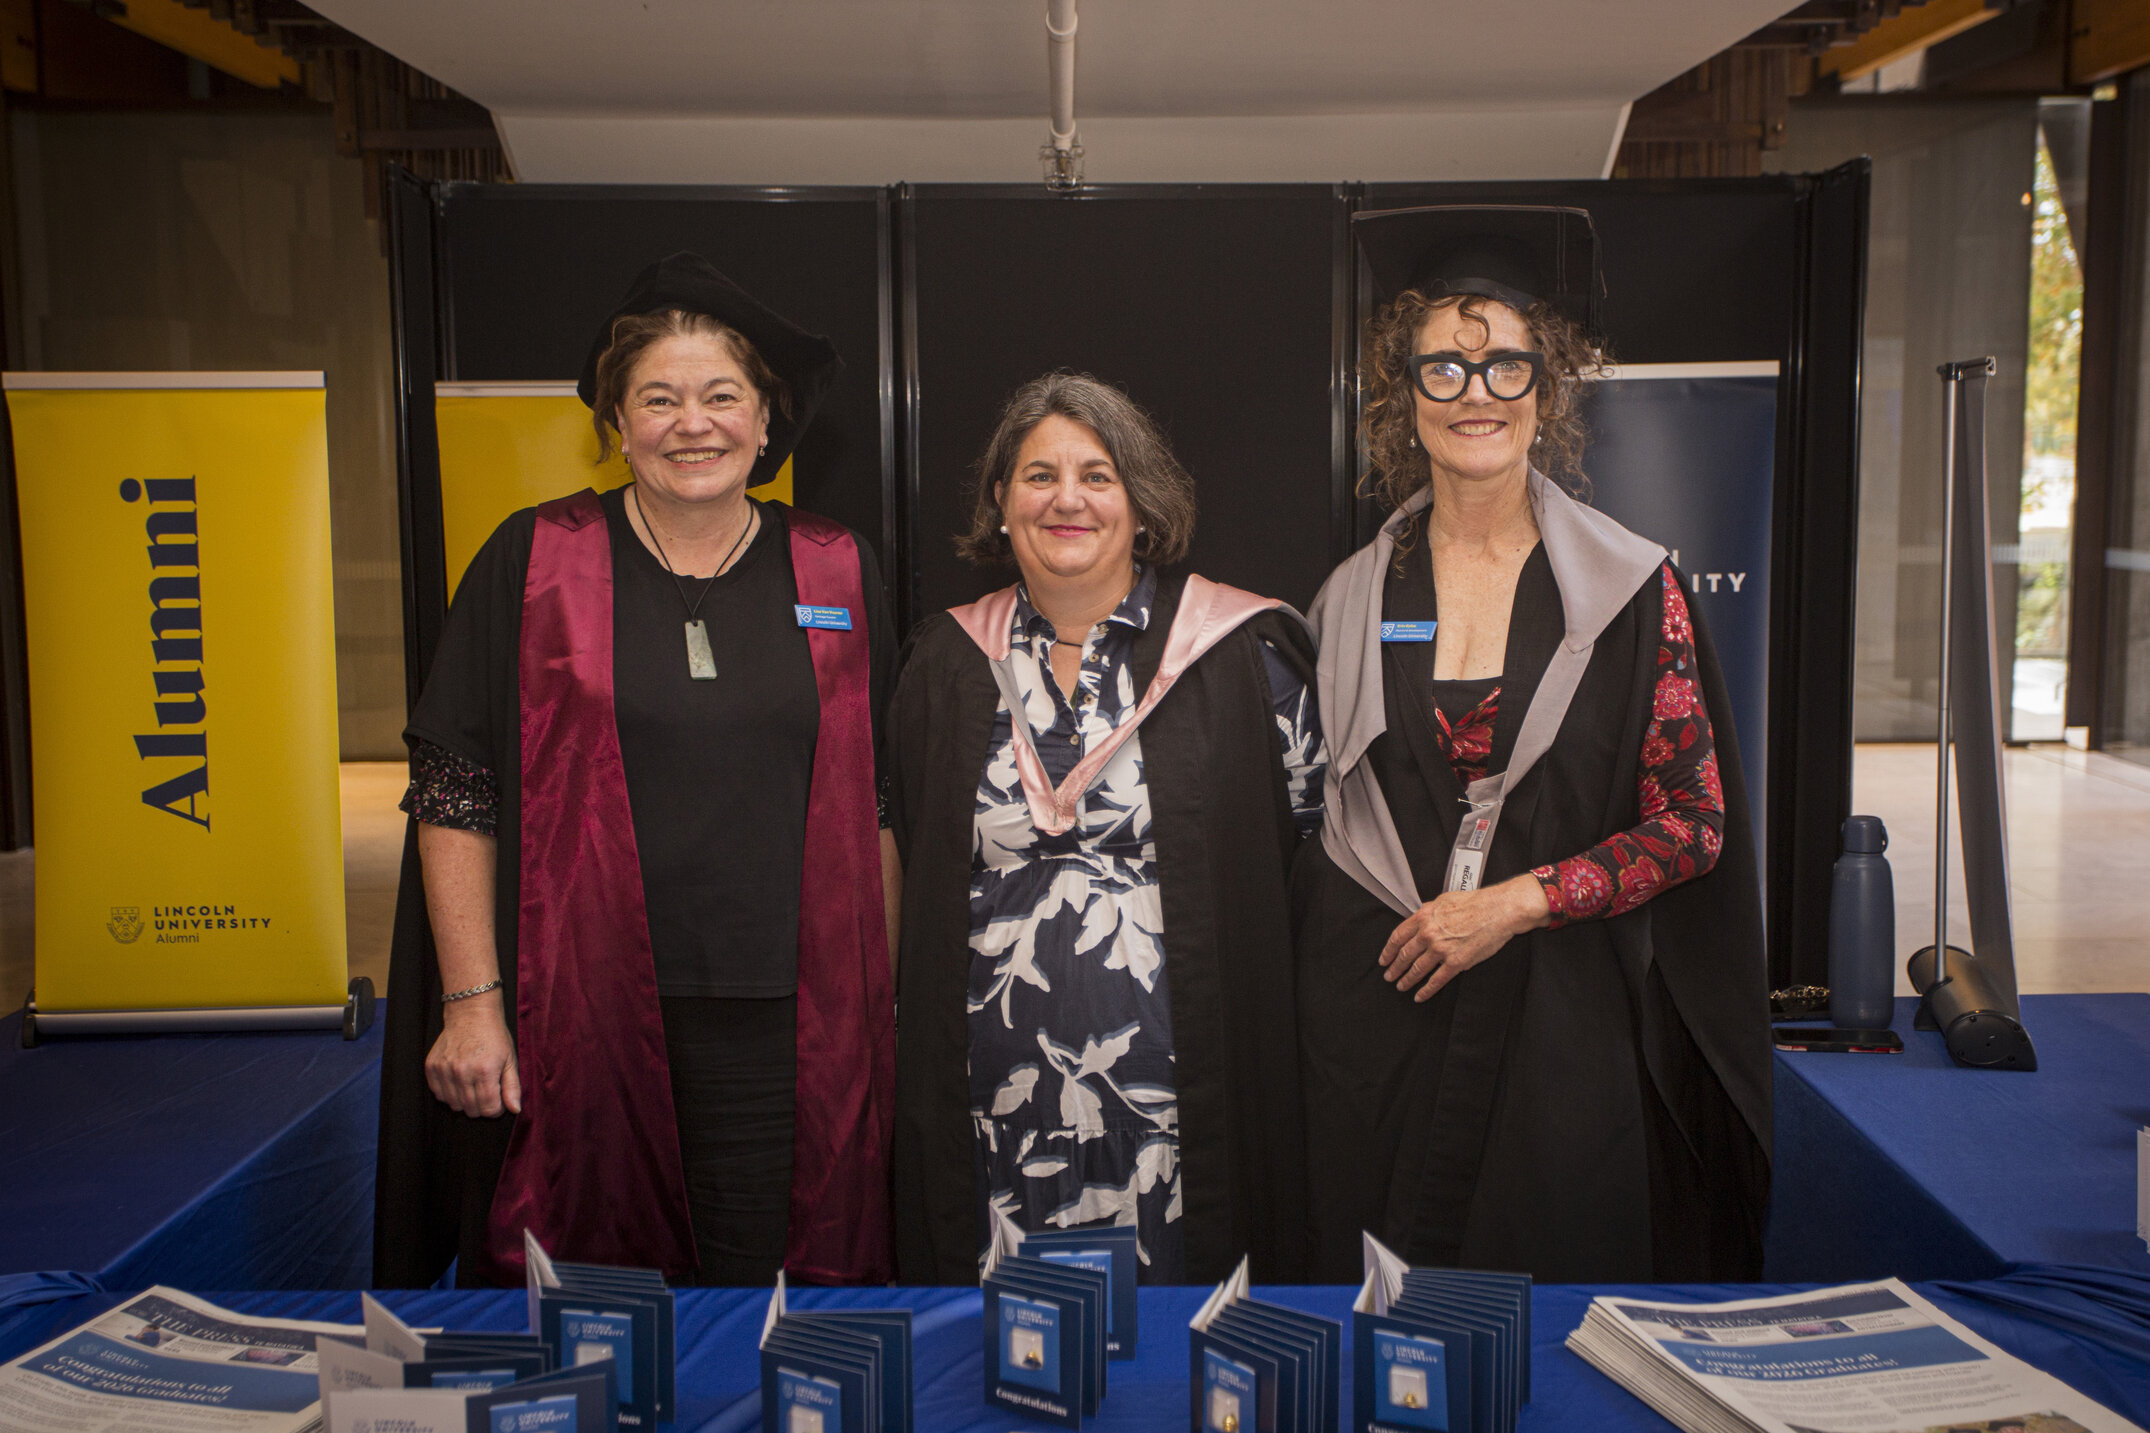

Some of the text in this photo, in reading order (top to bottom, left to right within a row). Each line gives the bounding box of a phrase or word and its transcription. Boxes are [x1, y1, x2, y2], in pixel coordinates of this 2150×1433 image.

[119, 474, 211, 833] Alumni
[1460, 864, 1471, 892] REGALI
[153, 905, 236, 917] LINCOLN
[154, 917, 272, 931] UNIVERSITY
[155, 932, 201, 945] Alumni
[1695, 1352, 1879, 1371] Congratulations to all
[42, 1362, 62, 1374] of
[62, 1369, 93, 1384] our
[57, 1355, 186, 1389] Congratulations
[188, 1382, 206, 1392] to
[206, 1384, 234, 1394] all
[995, 1386, 1068, 1418] Congratulations
